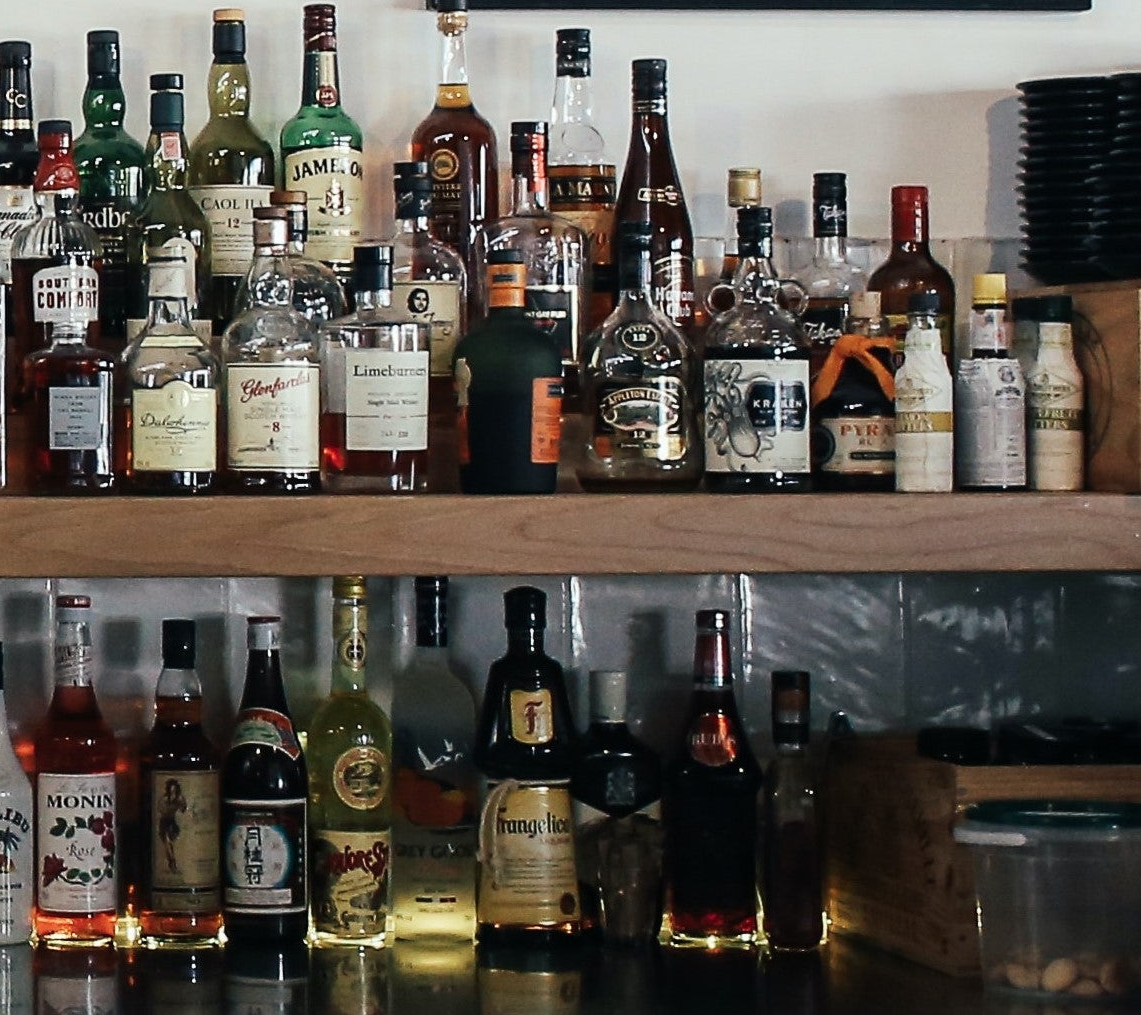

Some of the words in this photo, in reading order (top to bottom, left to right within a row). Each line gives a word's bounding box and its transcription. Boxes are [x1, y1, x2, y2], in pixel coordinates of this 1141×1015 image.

[292, 157, 363, 183] JAMEO
[226, 217, 241, 229] 12
[271, 421, 281, 433] 8
[46, 794, 114, 809] MONIN
